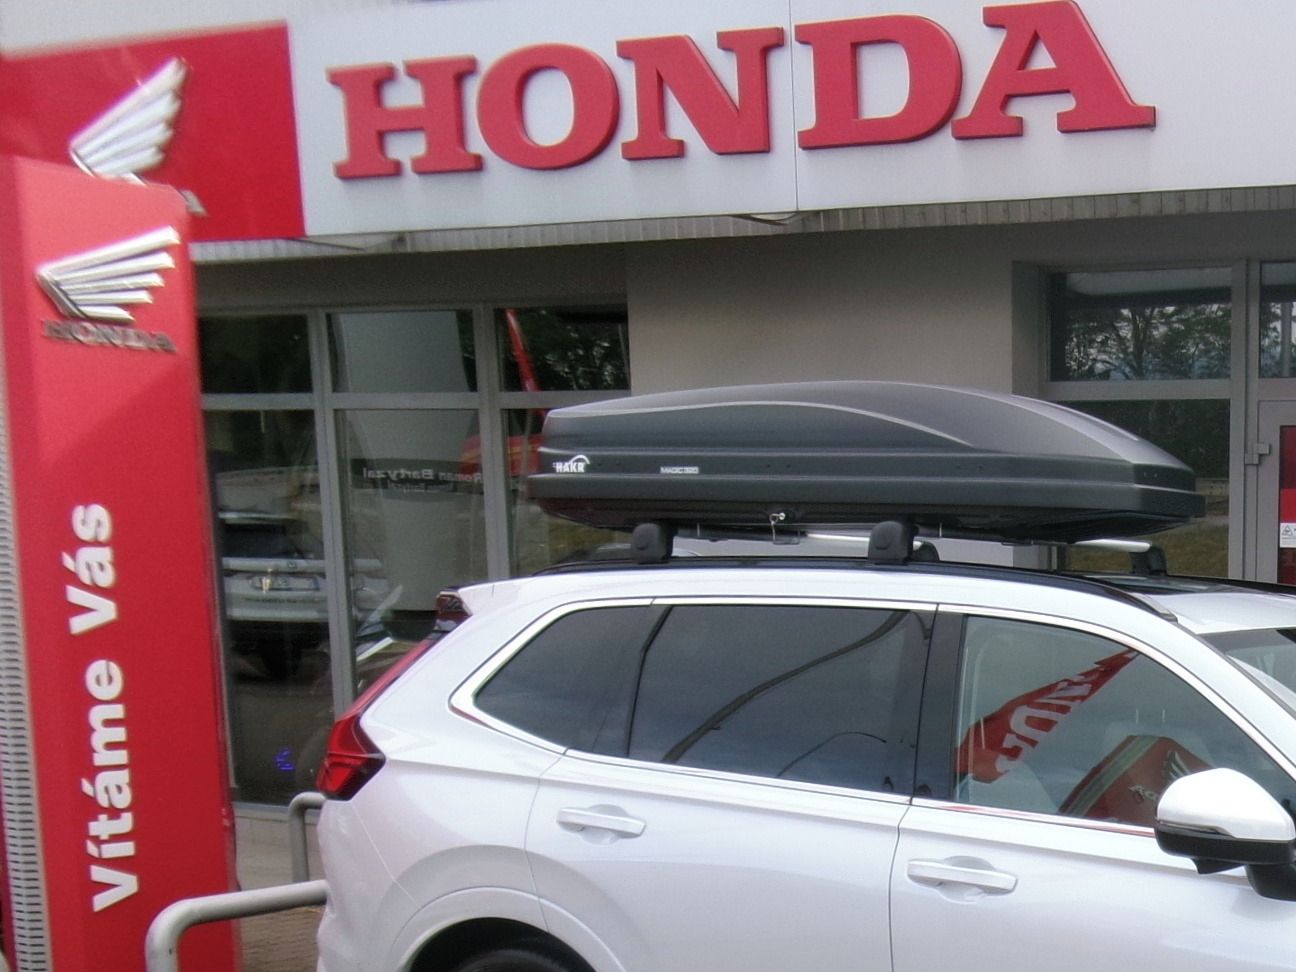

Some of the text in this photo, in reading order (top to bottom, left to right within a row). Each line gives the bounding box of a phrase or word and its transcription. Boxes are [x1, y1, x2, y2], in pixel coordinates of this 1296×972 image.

[326, 0, 1156, 179] HONDA
[41, 318, 177, 353] HONDA
[62, 503, 139, 912] Vítáme Vás
